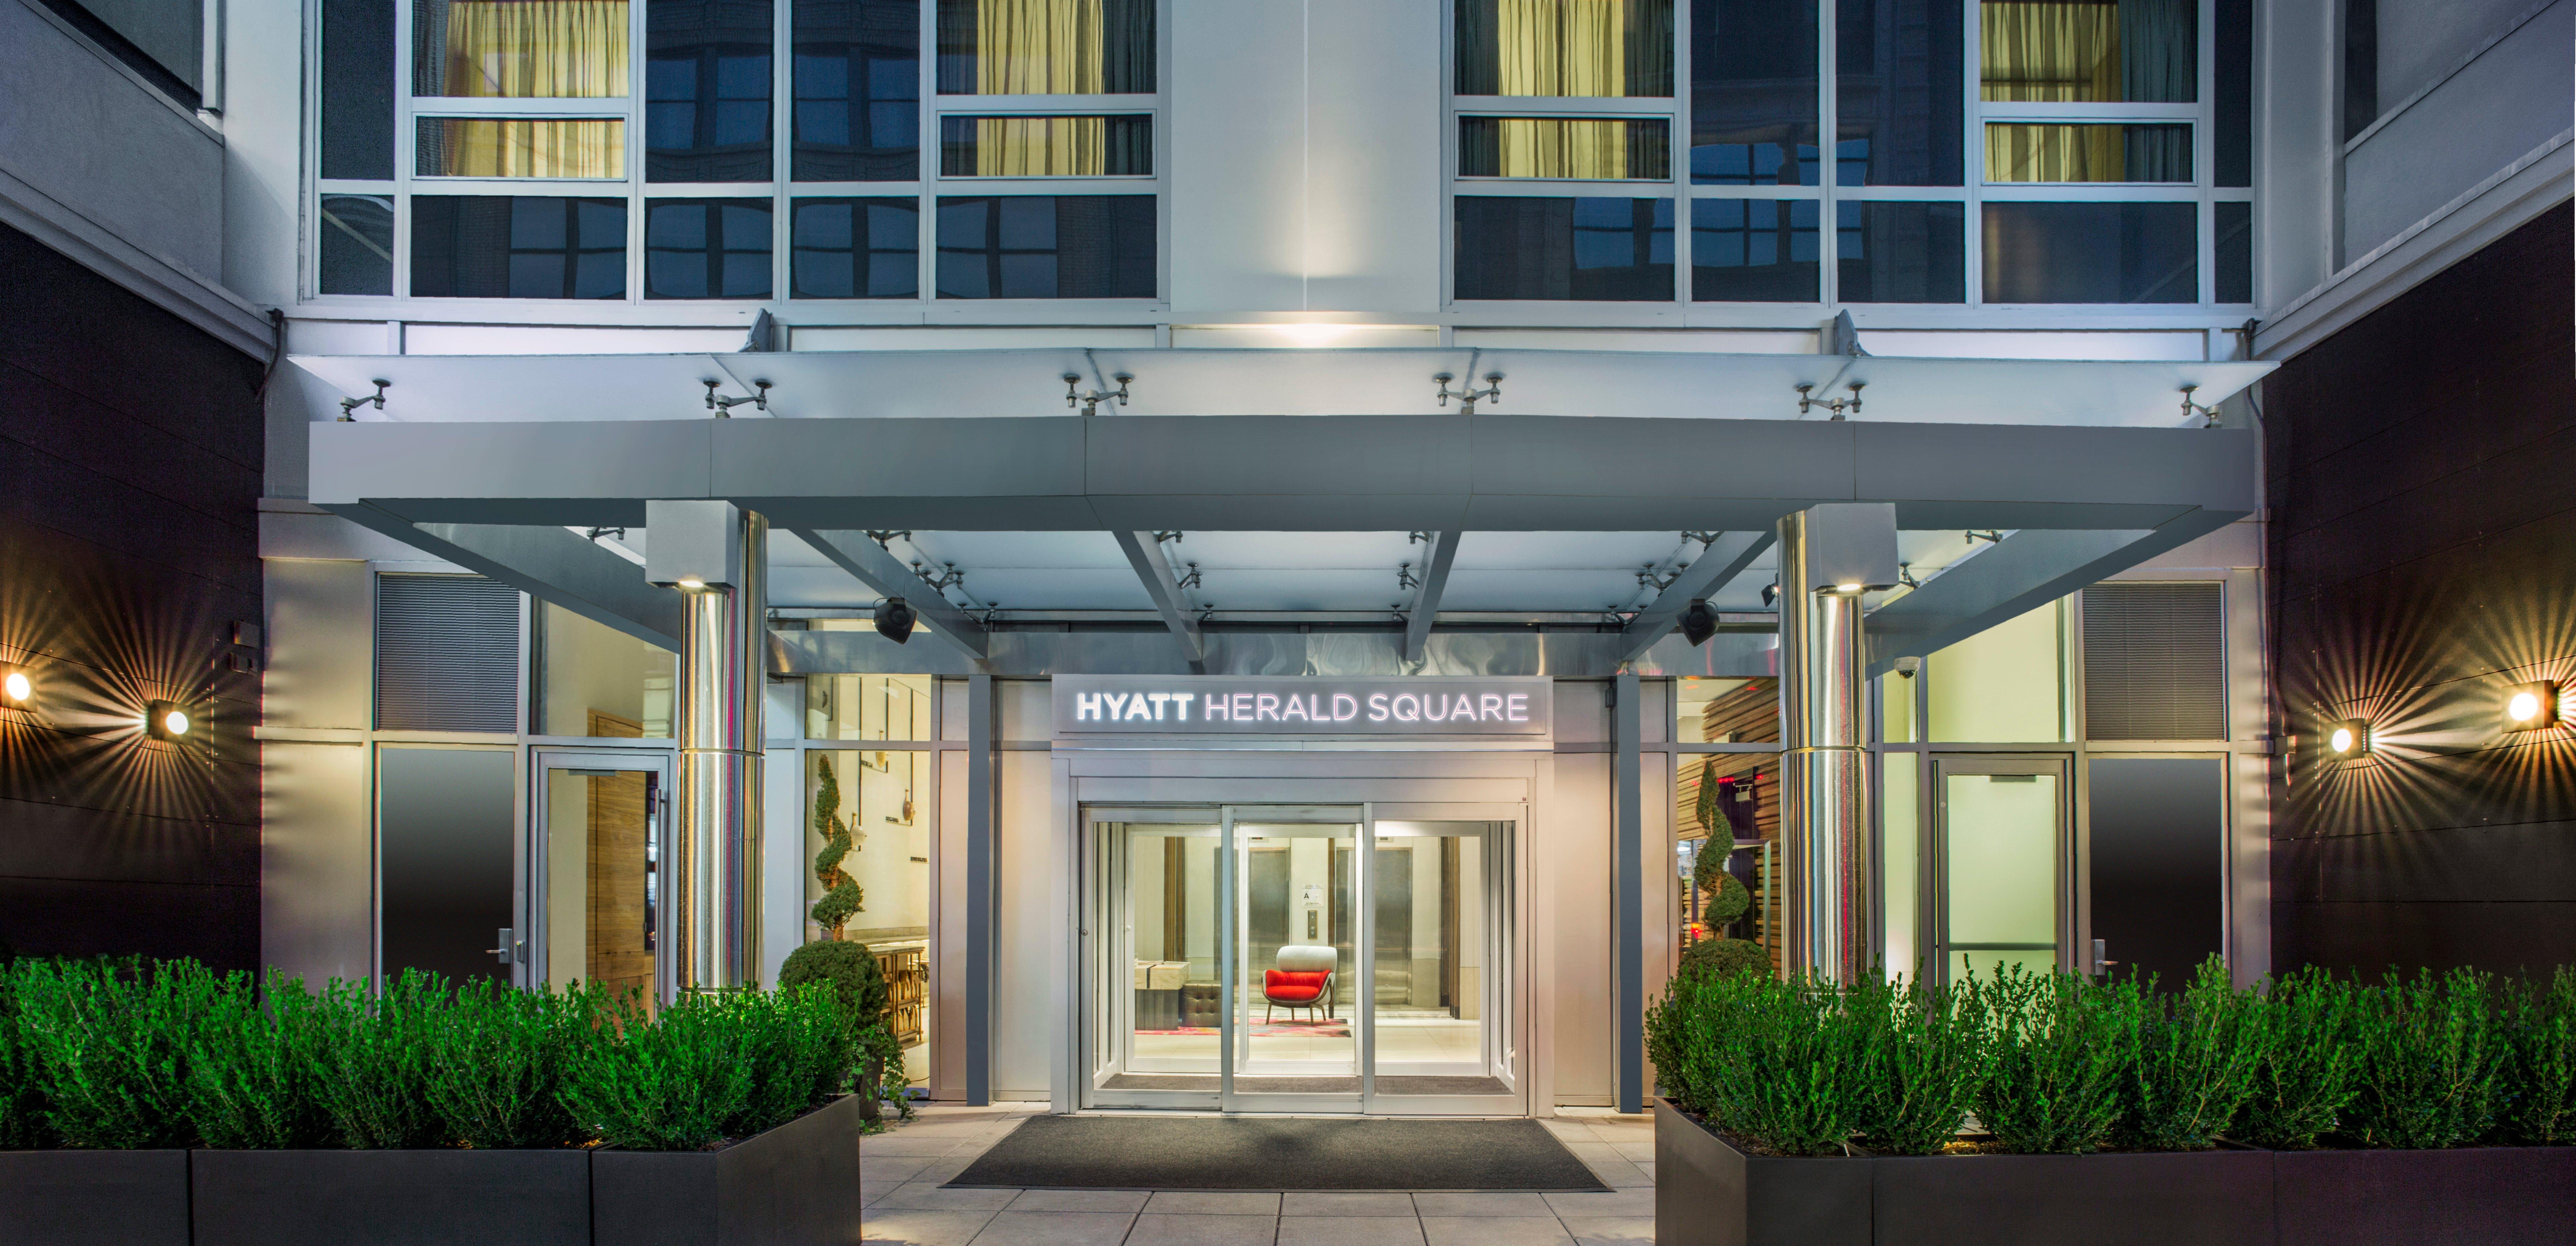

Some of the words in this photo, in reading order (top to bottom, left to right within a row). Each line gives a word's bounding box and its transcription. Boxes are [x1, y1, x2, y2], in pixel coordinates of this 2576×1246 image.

[1077, 694, 1193, 719] HYATT
[1206, 694, 1358, 720] HERALD
[1369, 694, 1528, 720] SQUARE
